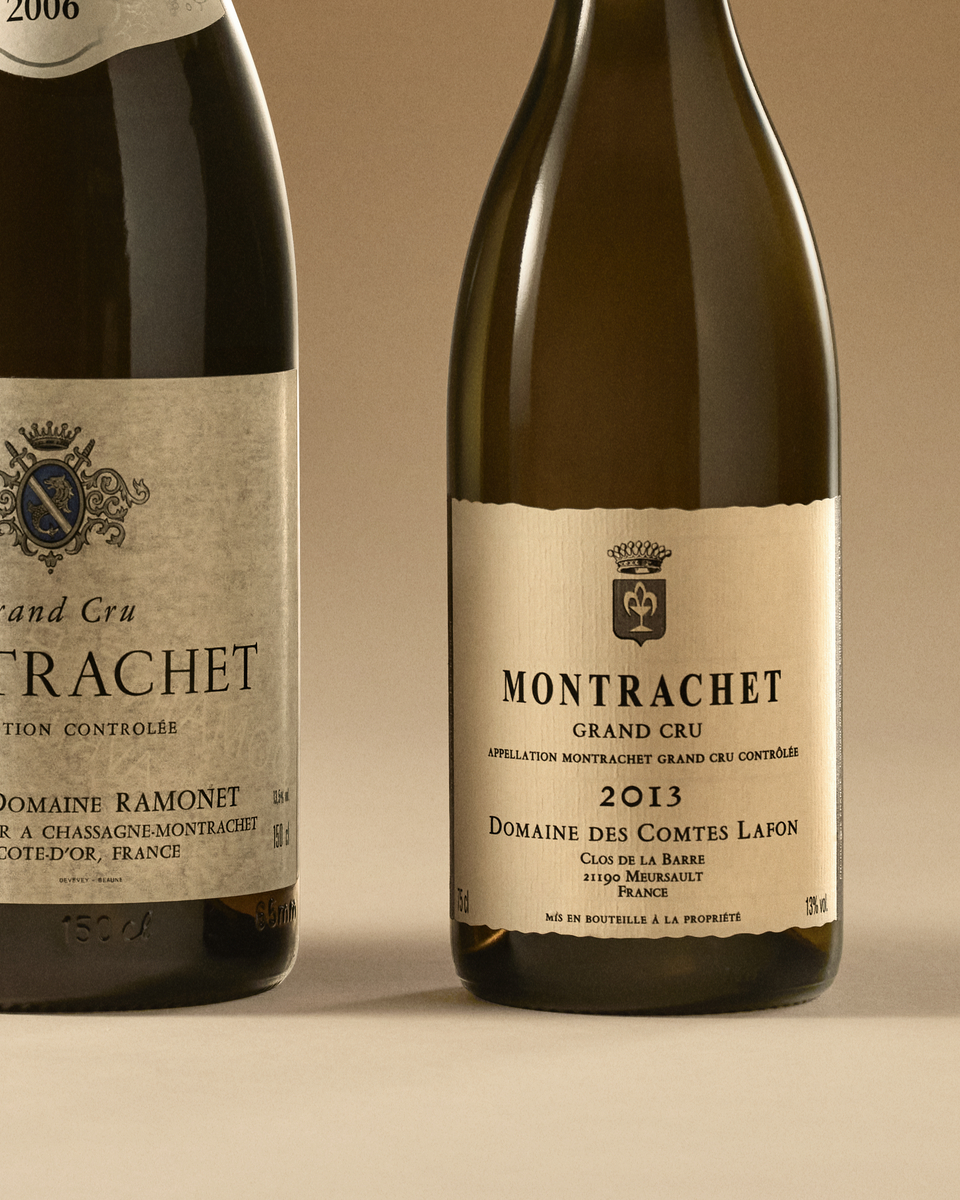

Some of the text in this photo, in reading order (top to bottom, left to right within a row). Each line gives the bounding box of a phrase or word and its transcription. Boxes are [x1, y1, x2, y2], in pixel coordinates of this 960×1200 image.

[81, 597, 136, 623] Cru
[502, 670, 782, 707] MONTRACHET
[64, 719, 178, 737] CONTROLÉE
[572, 723, 703, 739] GRAND CRU
[488, 746, 799, 764] APPELLATION MONTRACHET GRAND CRU CONTRÔLÉE
[115, 786, 240, 812] RAMONET
[600, 785, 682, 807] 2013
[20, 826, 33, 840] A
[42, 816, 258, 840] CHASSAGNE-MONTRACHET
[112, 845, 181, 861] FRANCE
[583, 873, 621, 886] 21190
[805, 895, 819, 916] 13%
[567, 914, 581, 923] EN
[585, 915, 647, 925] BOUTEILLE
[651, 914, 660, 924] À
[665, 915, 679, 924] LA
[684, 912, 741, 923] PROPRIÉTÉ
[61, 914, 112, 945] 150
